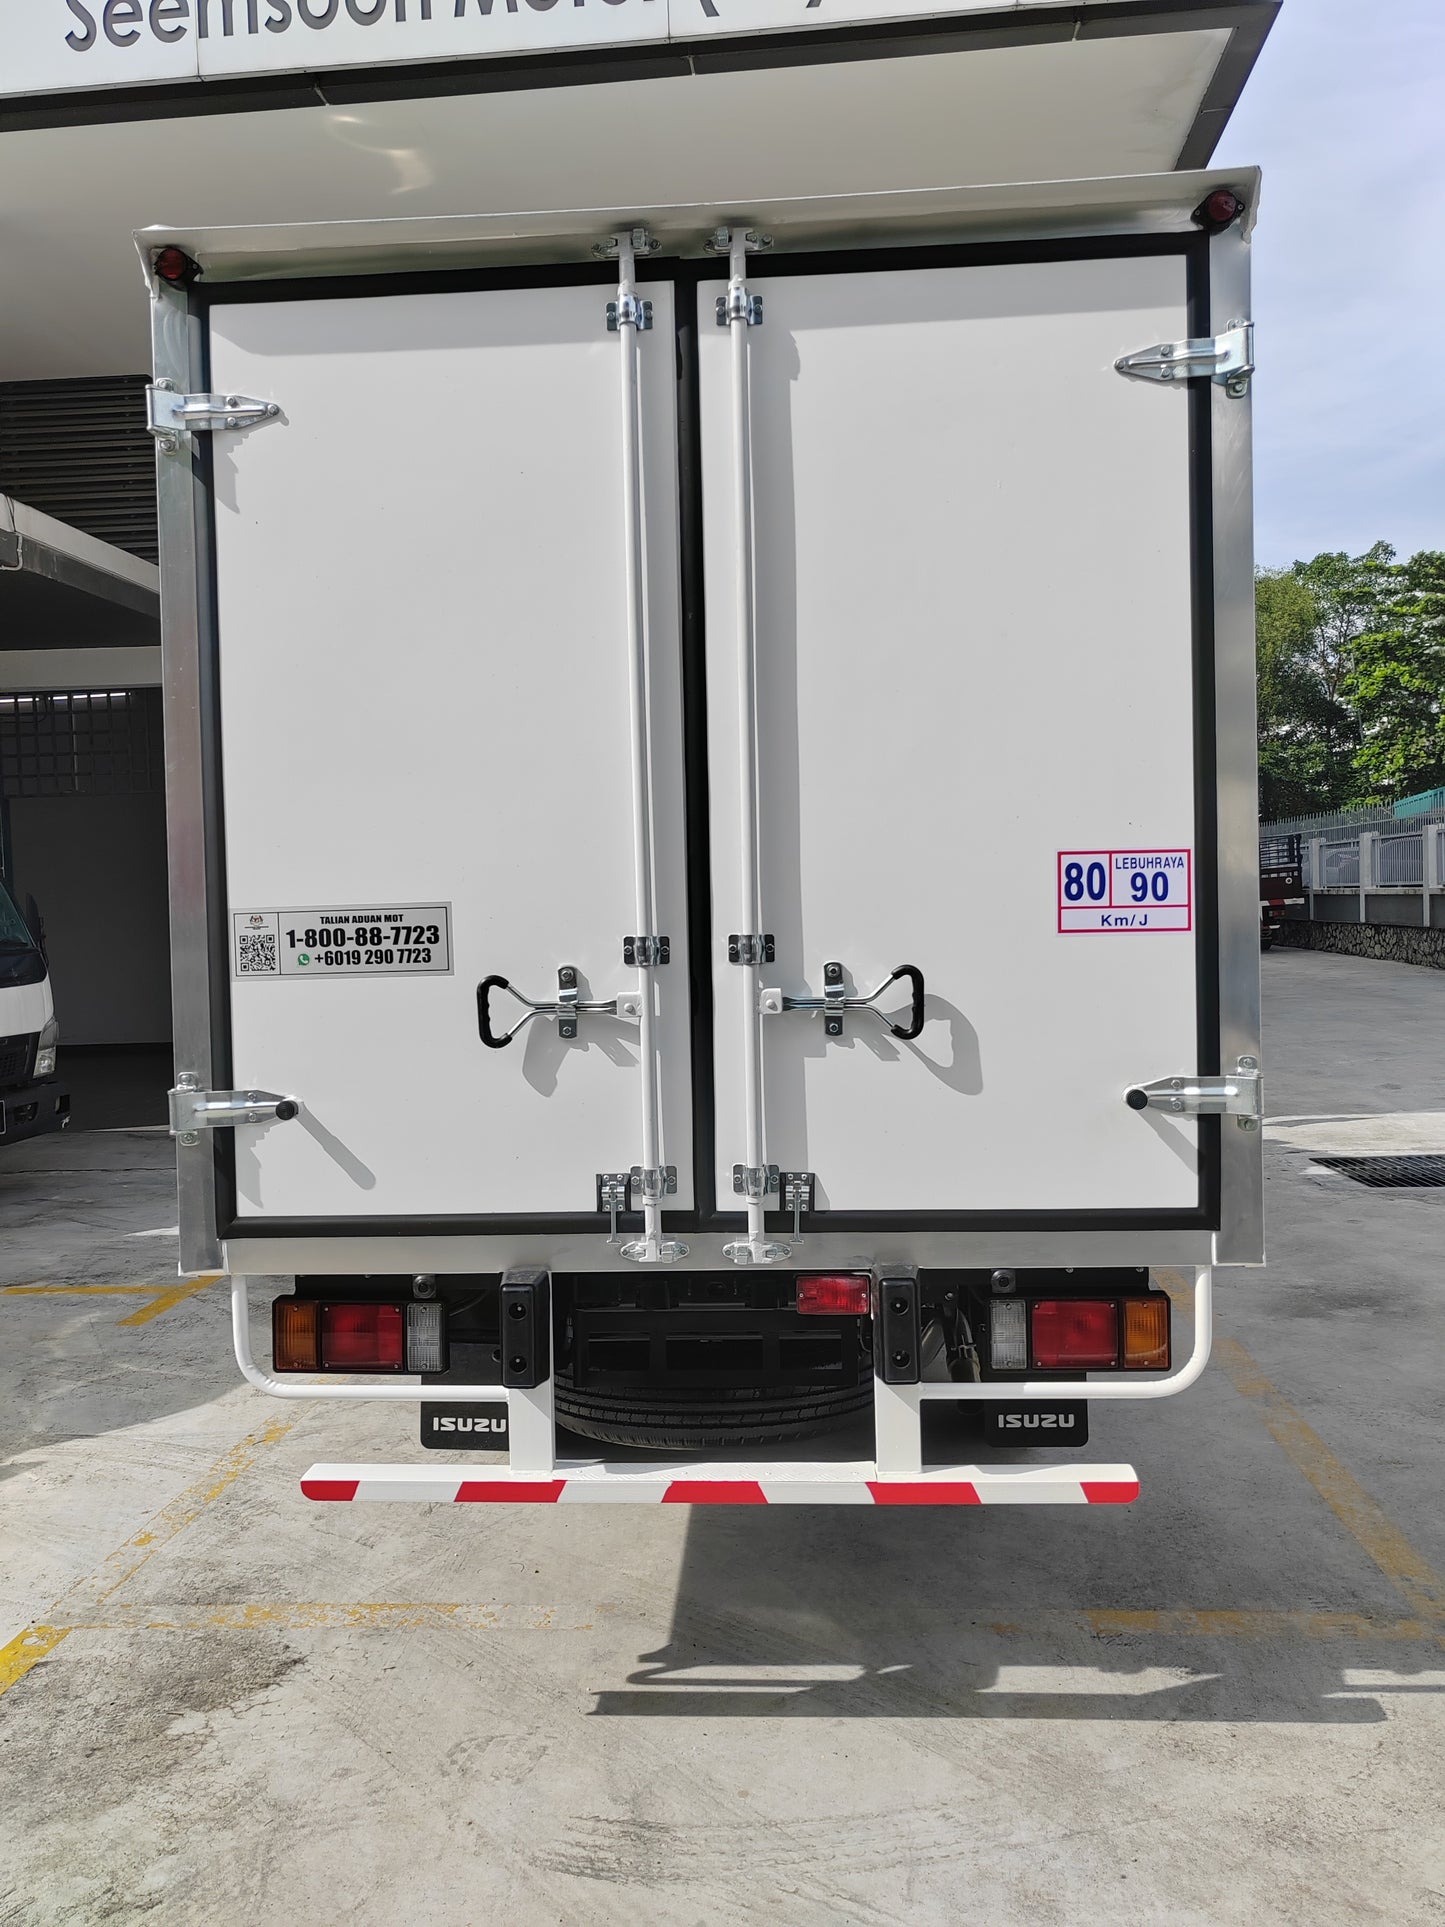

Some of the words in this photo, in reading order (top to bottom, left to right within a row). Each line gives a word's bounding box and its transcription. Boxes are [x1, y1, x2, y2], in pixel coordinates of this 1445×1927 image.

[1115, 856, 1185, 869] LEBUHRAYA
[1064, 862, 1106, 901] 80
[1130, 871, 1169, 902] 90
[320, 915, 350, 924] TALIAN
[351, 914, 382, 924] ADUAN
[383, 914, 404, 923] MOT
[286, 925, 440, 949] 1-800-88-7723
[314, 950, 362, 966] +6019
[364, 949, 394, 965] 290
[396, 948, 432, 964] 7723
[433, 1417, 507, 1432] ISUZU
[998, 1414, 1075, 1428] ISUZU
